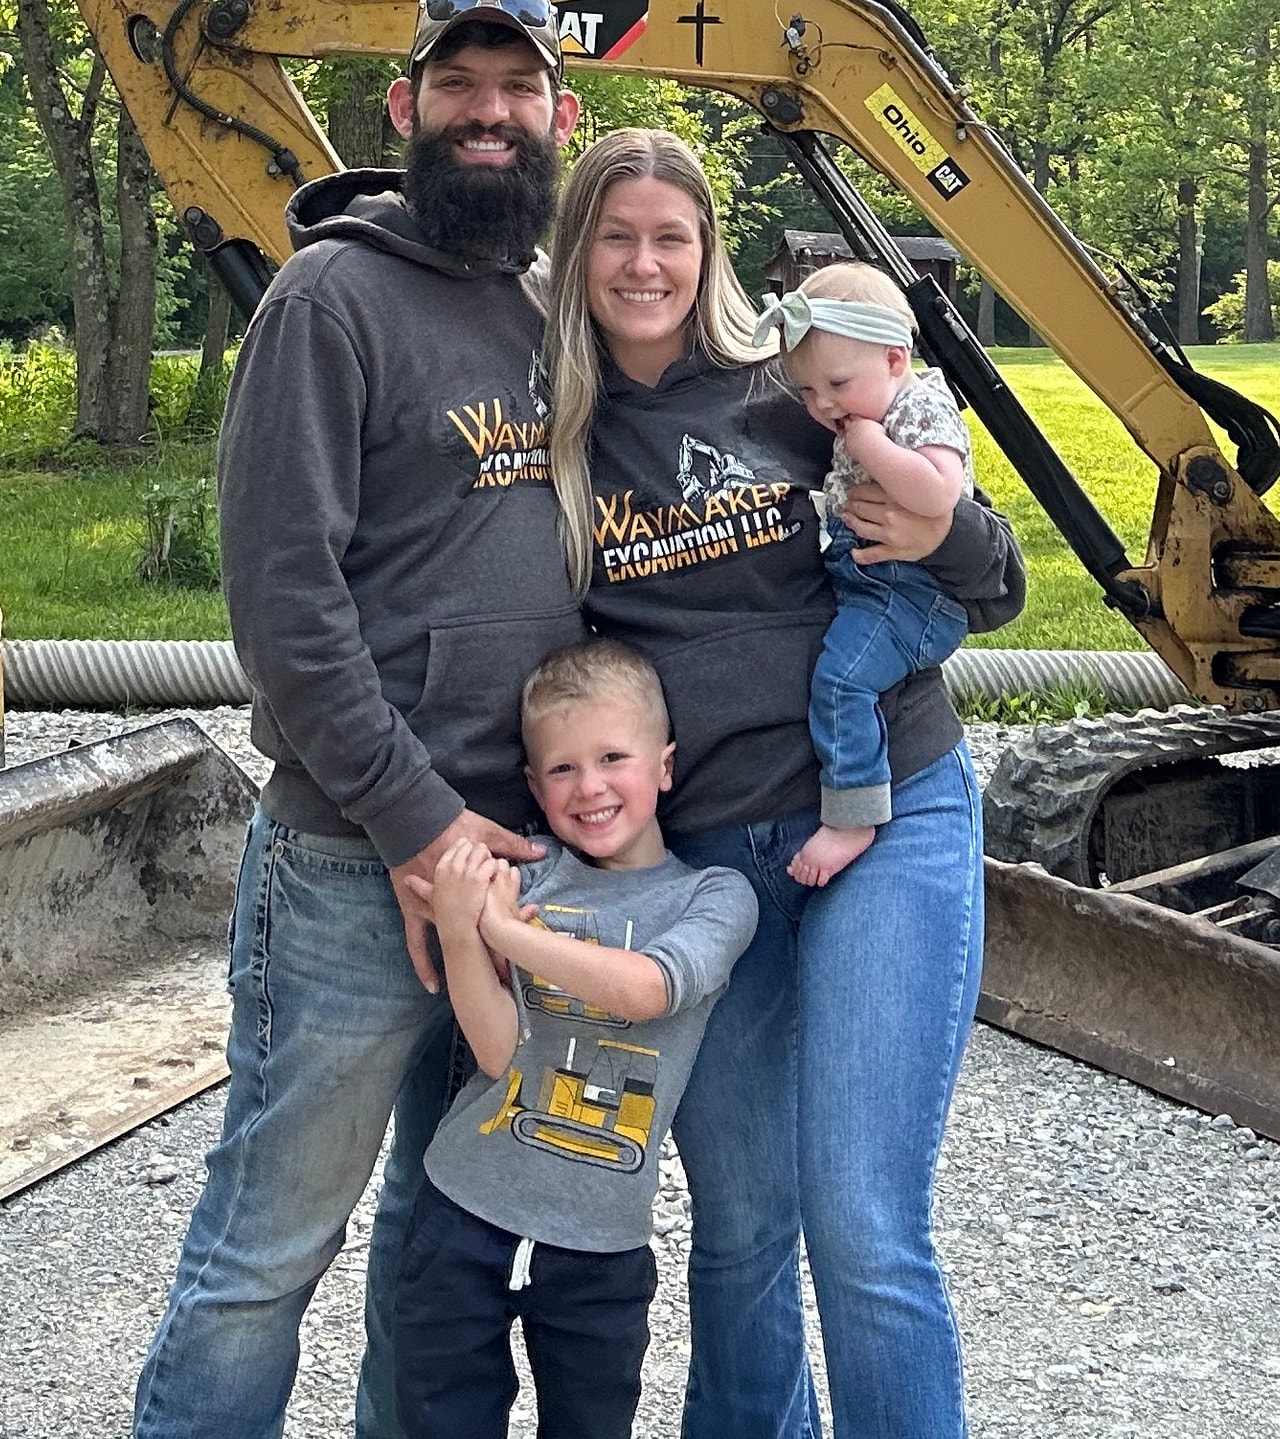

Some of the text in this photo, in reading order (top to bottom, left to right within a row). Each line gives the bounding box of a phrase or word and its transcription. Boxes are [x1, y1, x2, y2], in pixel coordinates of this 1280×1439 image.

[559, 11, 604, 55] AT
[882, 104, 926, 156] Ohio
[934, 164, 965, 193] CAT
[446, 397, 548, 460] WAYM
[593, 482, 791, 549] WAYMAKER
[602, 506, 784, 584] EXCAVATION LLC
